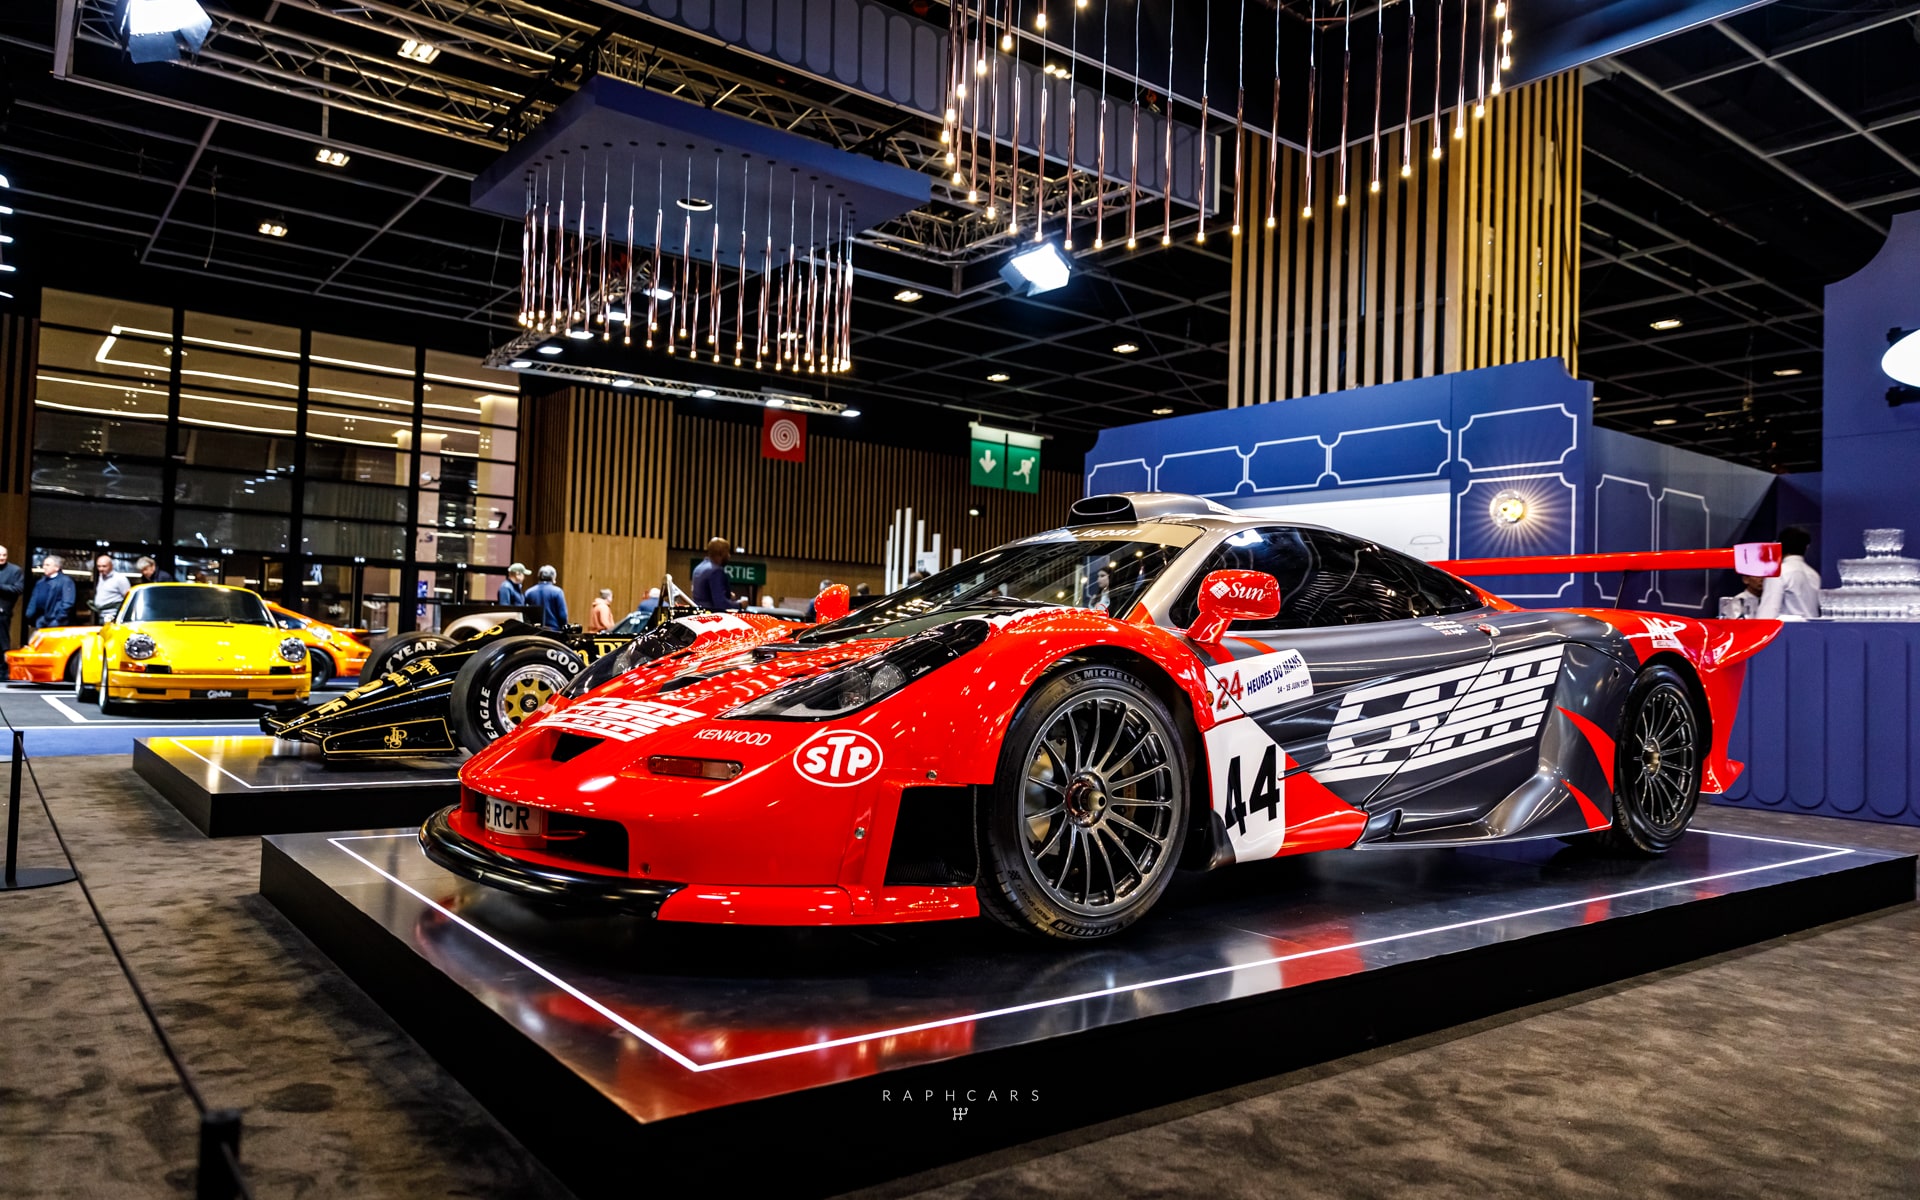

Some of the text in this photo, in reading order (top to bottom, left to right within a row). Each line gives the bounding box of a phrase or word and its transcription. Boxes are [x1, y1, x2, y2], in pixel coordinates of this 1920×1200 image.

[723, 565, 755, 580] RTIE
[1229, 581, 1265, 601] Sun
[546, 648, 580, 674] GOO
[1083, 669, 1143, 689] MICHELIN
[1216, 655, 1302, 712] 24 HEURES DU MANS
[480, 686, 499, 741] EAGLE
[693, 728, 772, 747] KENWOOD
[803, 736, 872, 778] STP
[1225, 743, 1280, 836] 44
[494, 803, 530, 831] RCR
[1055, 920, 1120, 937] MICHELIN
